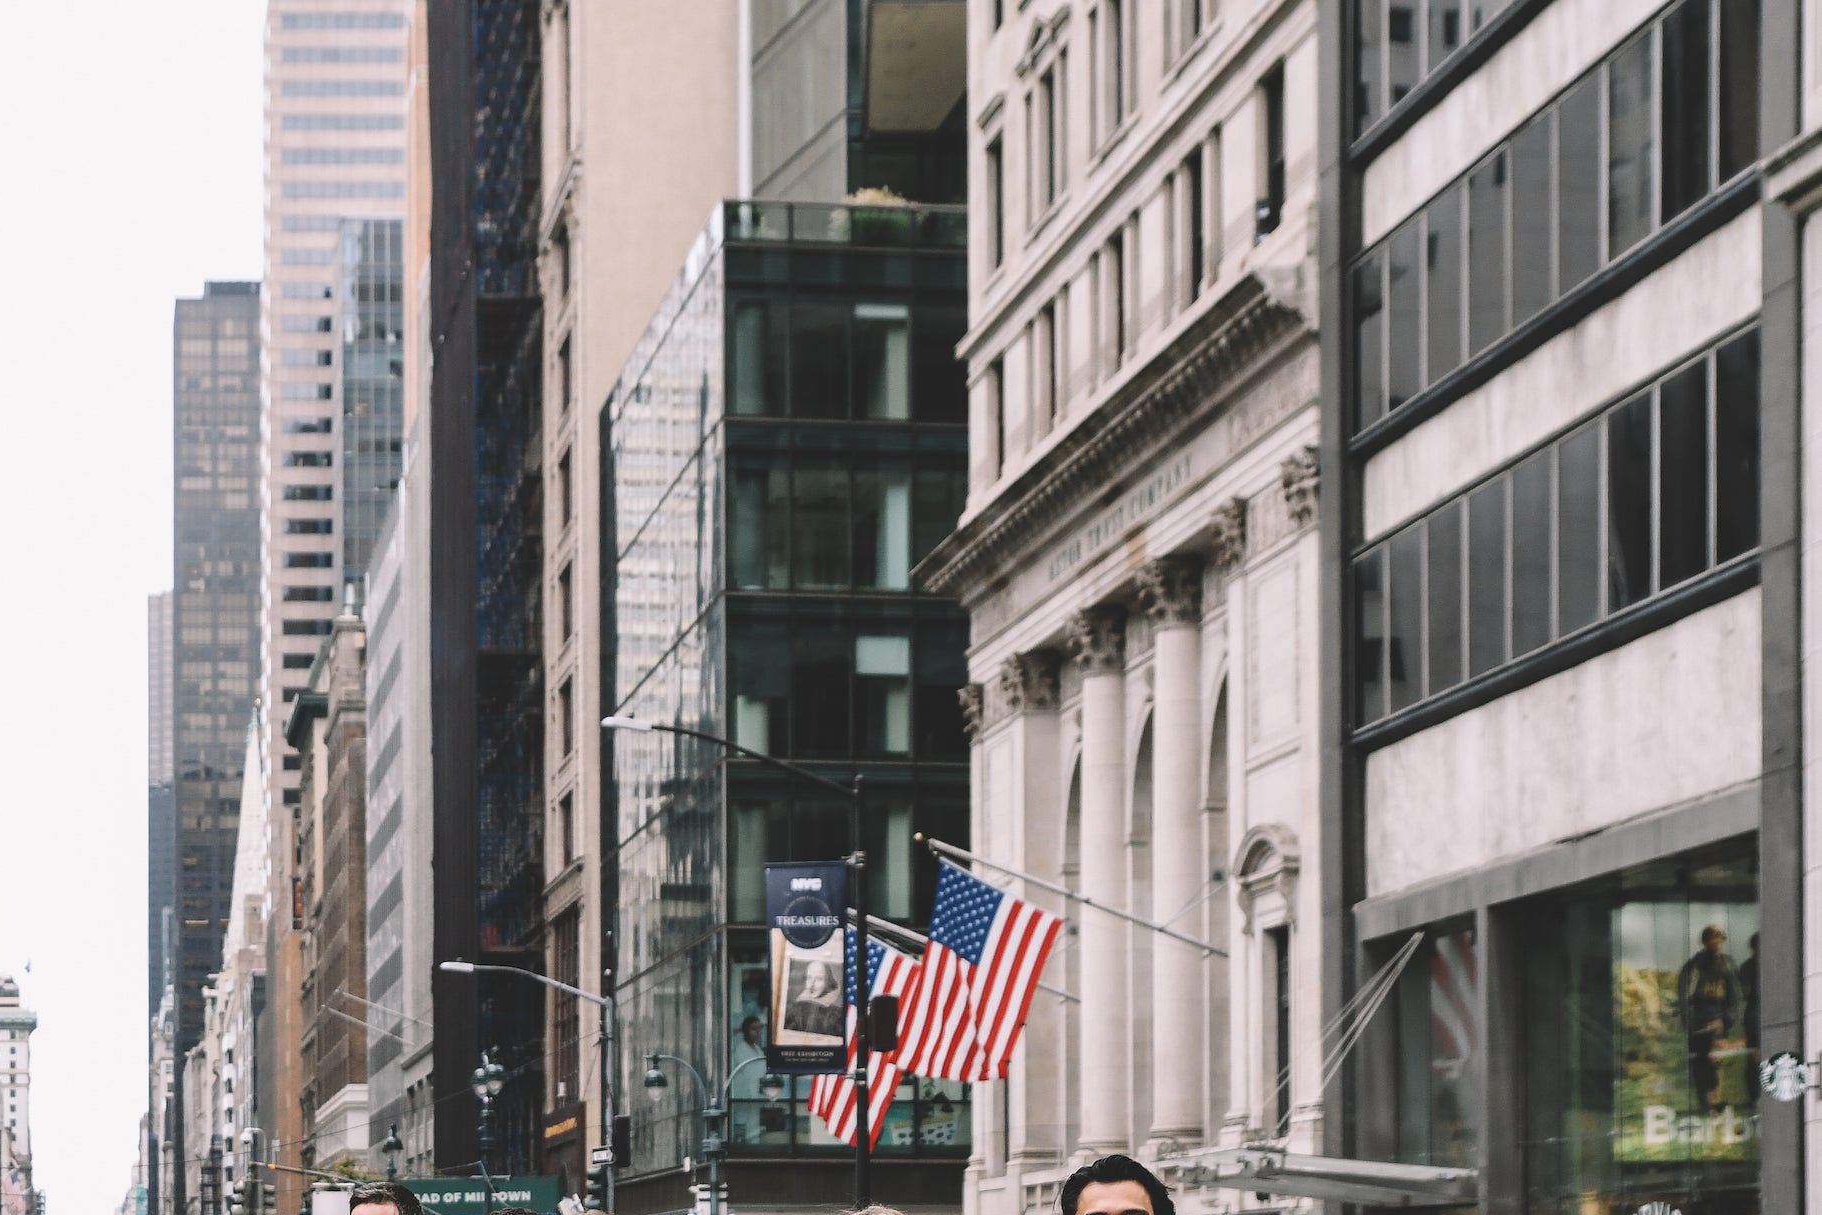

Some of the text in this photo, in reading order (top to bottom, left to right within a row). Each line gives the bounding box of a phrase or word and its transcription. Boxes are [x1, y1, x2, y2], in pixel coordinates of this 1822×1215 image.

[776, 915, 839, 926] TREASURES
[443, 1192, 462, 1203] OF
[464, 1191, 531, 1202] MITOWN
